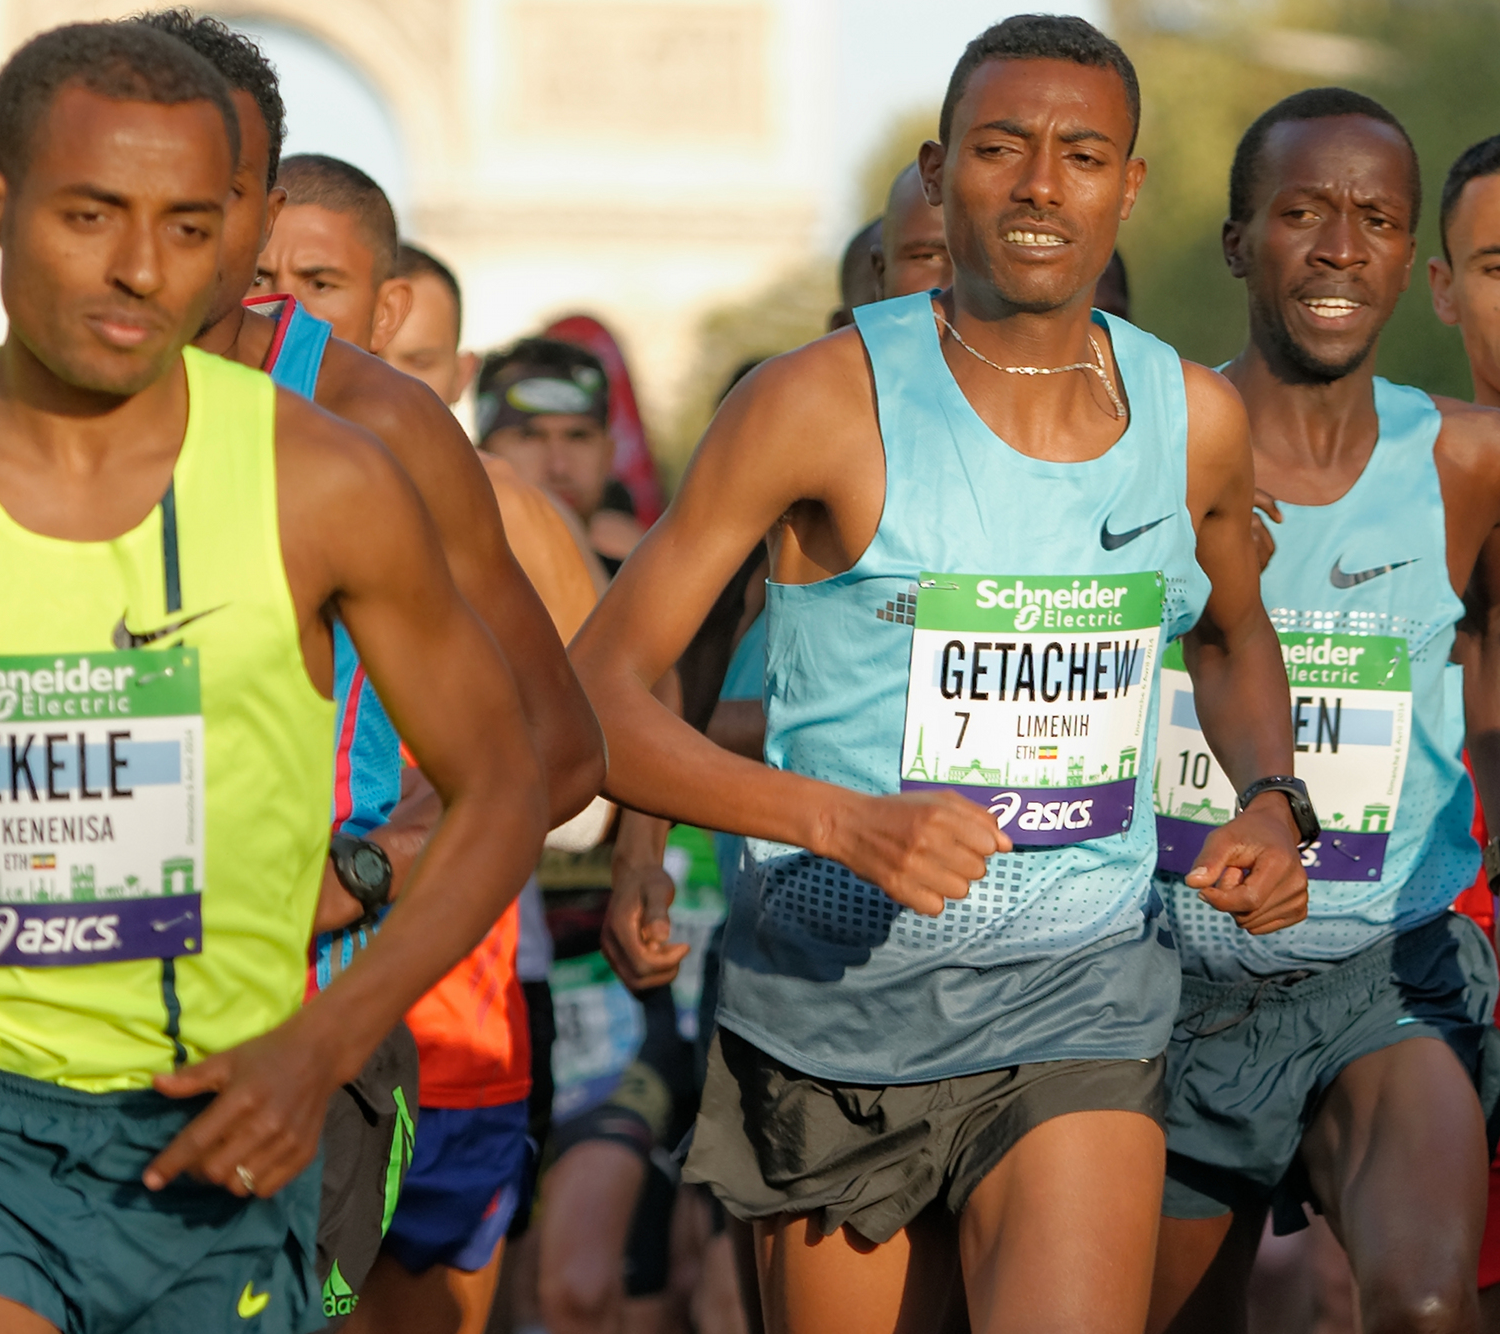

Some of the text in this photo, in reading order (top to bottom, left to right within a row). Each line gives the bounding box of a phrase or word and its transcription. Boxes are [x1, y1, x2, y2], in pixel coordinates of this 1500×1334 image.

[976, 579, 1128, 610] Schneider
[1043, 610, 1123, 628] Electric
[939, 638, 1140, 704] GETACHEW
[21, 694, 130, 716] Electric
[954, 711, 971, 749] 7
[1016, 714, 1090, 738] LIMENIH
[1016, 745, 1036, 760] ETH
[1178, 750, 1211, 790] 10
[2, 815, 115, 845] KENENISA
[1018, 799, 1094, 831] asics
[4, 853, 28, 870] ETH
[15, 915, 119, 954] asics
